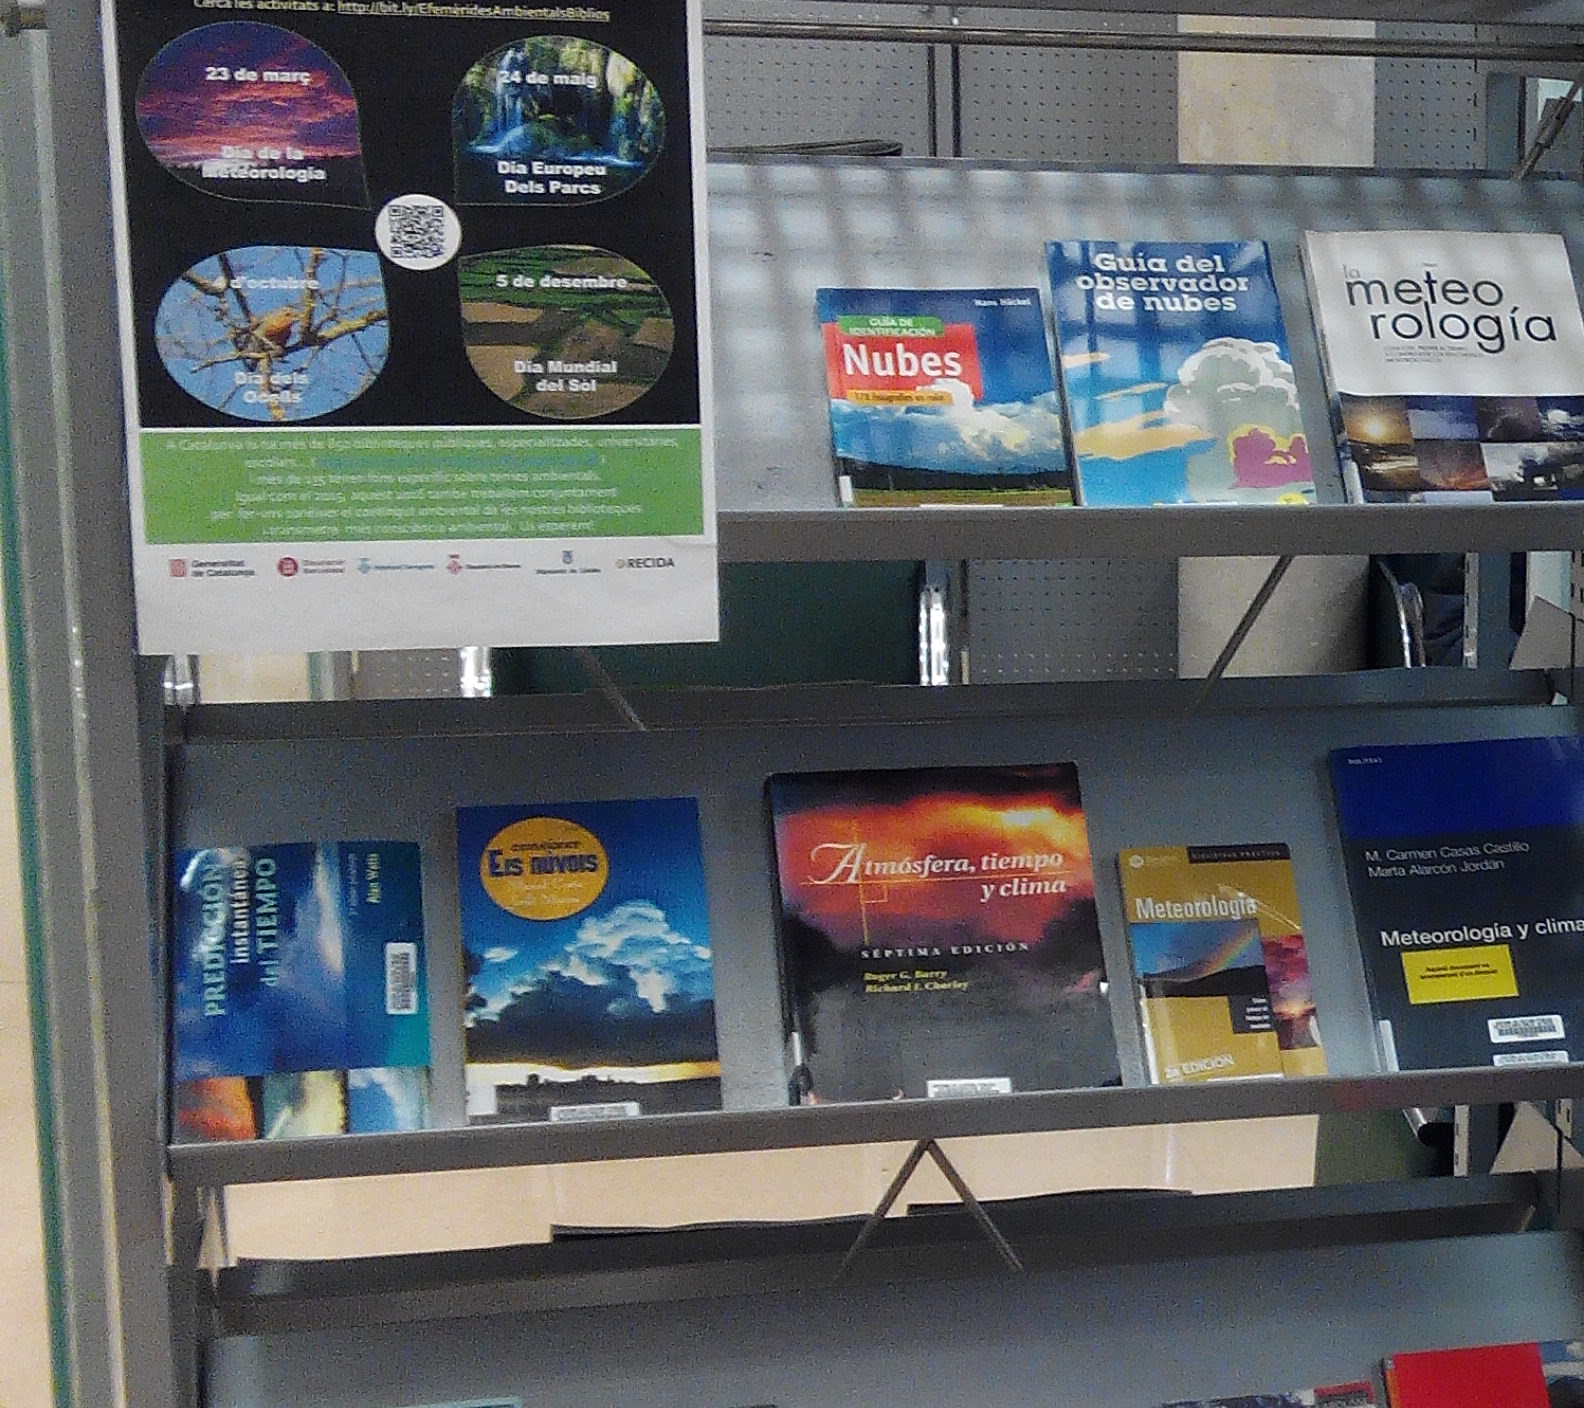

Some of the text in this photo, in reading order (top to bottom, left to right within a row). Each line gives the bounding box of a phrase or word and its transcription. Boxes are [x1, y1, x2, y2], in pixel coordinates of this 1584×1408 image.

[205, 67, 312, 86] 23 de març
[499, 70, 598, 88] 24 de maig
[258, 146, 281, 160] de
[286, 147, 304, 161] la
[532, 161, 607, 178] Europeu
[504, 180, 602, 195] Dels Parcs
[1092, 252, 1226, 274] Guía del
[1343, 264, 1361, 279] la
[496, 274, 628, 290] 5 de desembre
[1075, 273, 1249, 293] observador
[1345, 270, 1504, 307] meteo
[1095, 291, 1238, 312] de nubes
[868, 316, 914, 327] GUÍA DE
[1370, 301, 1559, 354] rología
[547, 360, 618, 375] Mundial
[843, 342, 962, 378] Nubes
[536, 378, 565, 393] del
[627, 557, 676, 570] RECIDA
[1365, 841, 1530, 862] M. Carmen Casas Castillo
[808, 842, 1064, 885] Atmósfera, tiempo
[1367, 864, 1406, 879] Marta
[1409, 860, 1457, 877] Alarcón
[980, 877, 1068, 903] y clima
[255, 856, 279, 955] TIEMPO
[200, 862, 228, 1017] PREDICCIÓN
[1379, 920, 1513, 947] Meteorología
[1517, 922, 1530, 941] y
[860, 942, 1030, 960] SÉPTIMA EDICIÓN
[865, 982, 912, 993] Richard
